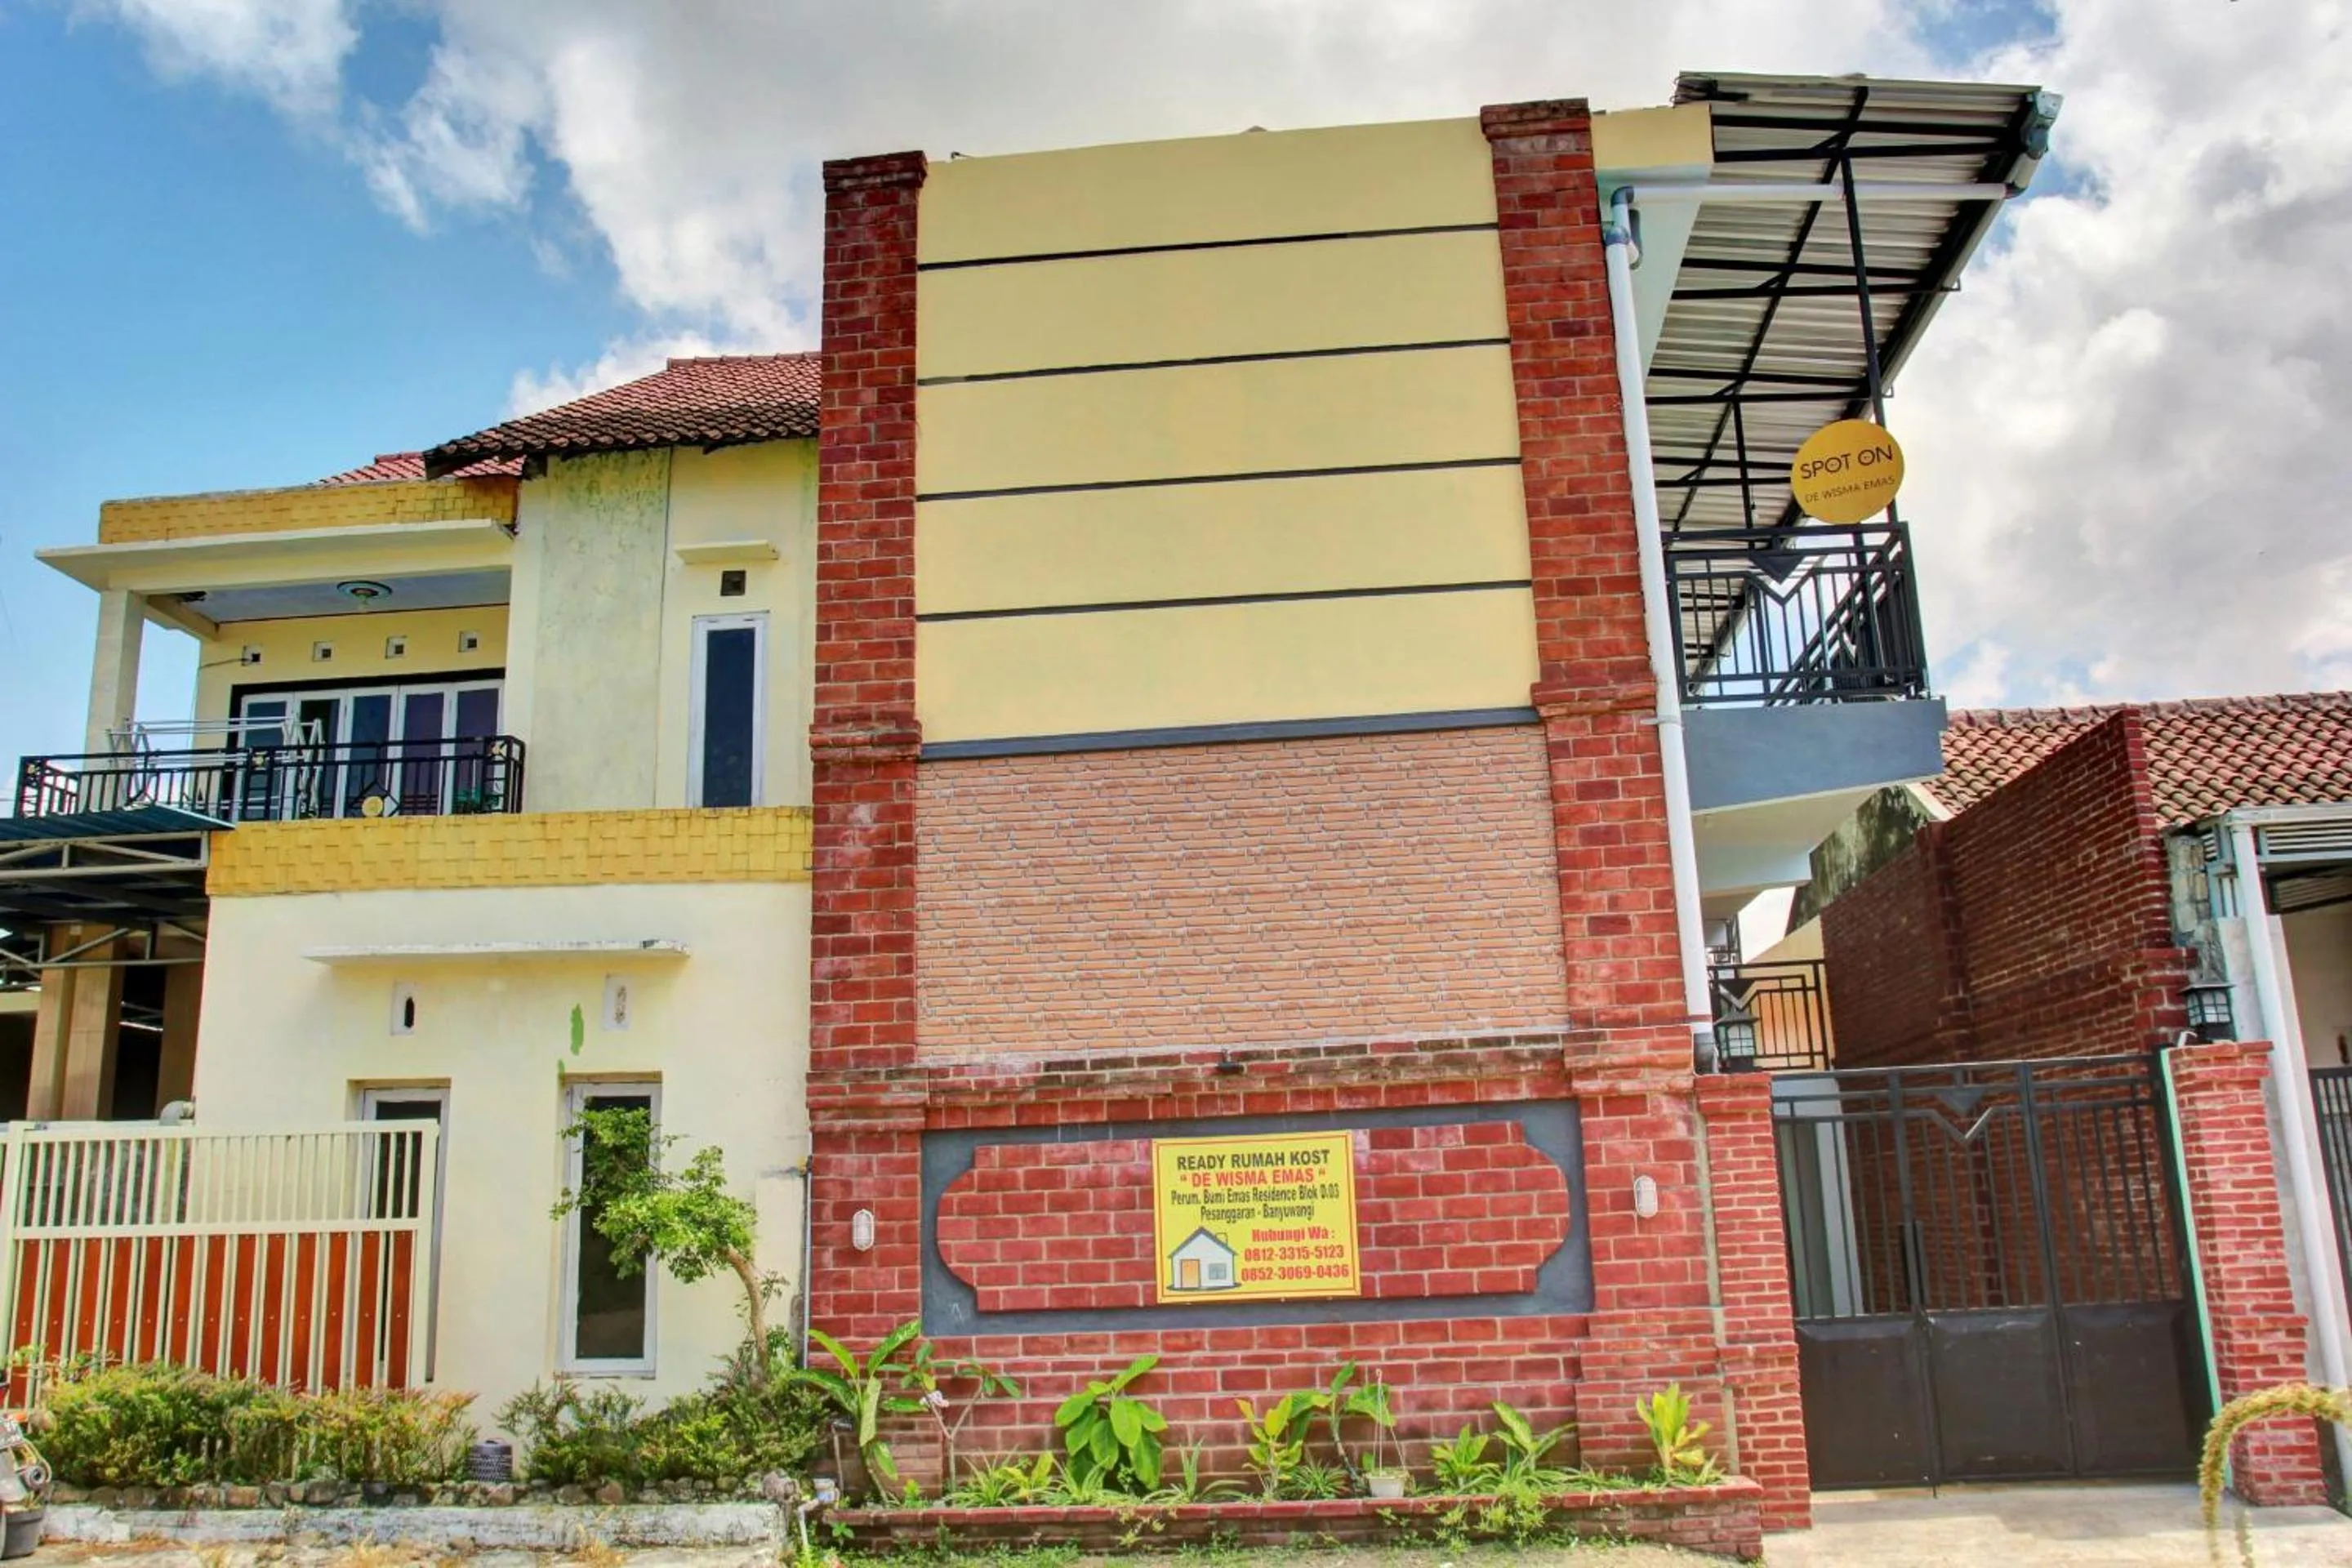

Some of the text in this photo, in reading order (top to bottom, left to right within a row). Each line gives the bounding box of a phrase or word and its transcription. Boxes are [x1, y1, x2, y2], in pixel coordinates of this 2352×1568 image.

[1800, 444, 1893, 479] SPOT ON
[1805, 476, 1895, 503] DE WISMA EMAS
[1177, 1149, 1330, 1170] READY RUMAH KOST
[1192, 1172, 1210, 1187] DE
[1216, 1169, 1267, 1186] WISMA
[1272, 1168, 1314, 1184] EMAS
[1203, 1189, 1225, 1204] Bumi
[1227, 1187, 1250, 1203] Emas
[1252, 1186, 1296, 1202] Residence
[1299, 1184, 1318, 1200] Blok
[1200, 1205, 1255, 1223] Pesanggaran
[1263, 1202, 1314, 1222] Banyuwangi
[1252, 1228, 1305, 1242] Hubungi
[1244, 1245, 1344, 1261] 0812-3315-5123
[1241, 1264, 1349, 1281] 0852-3069-0436
